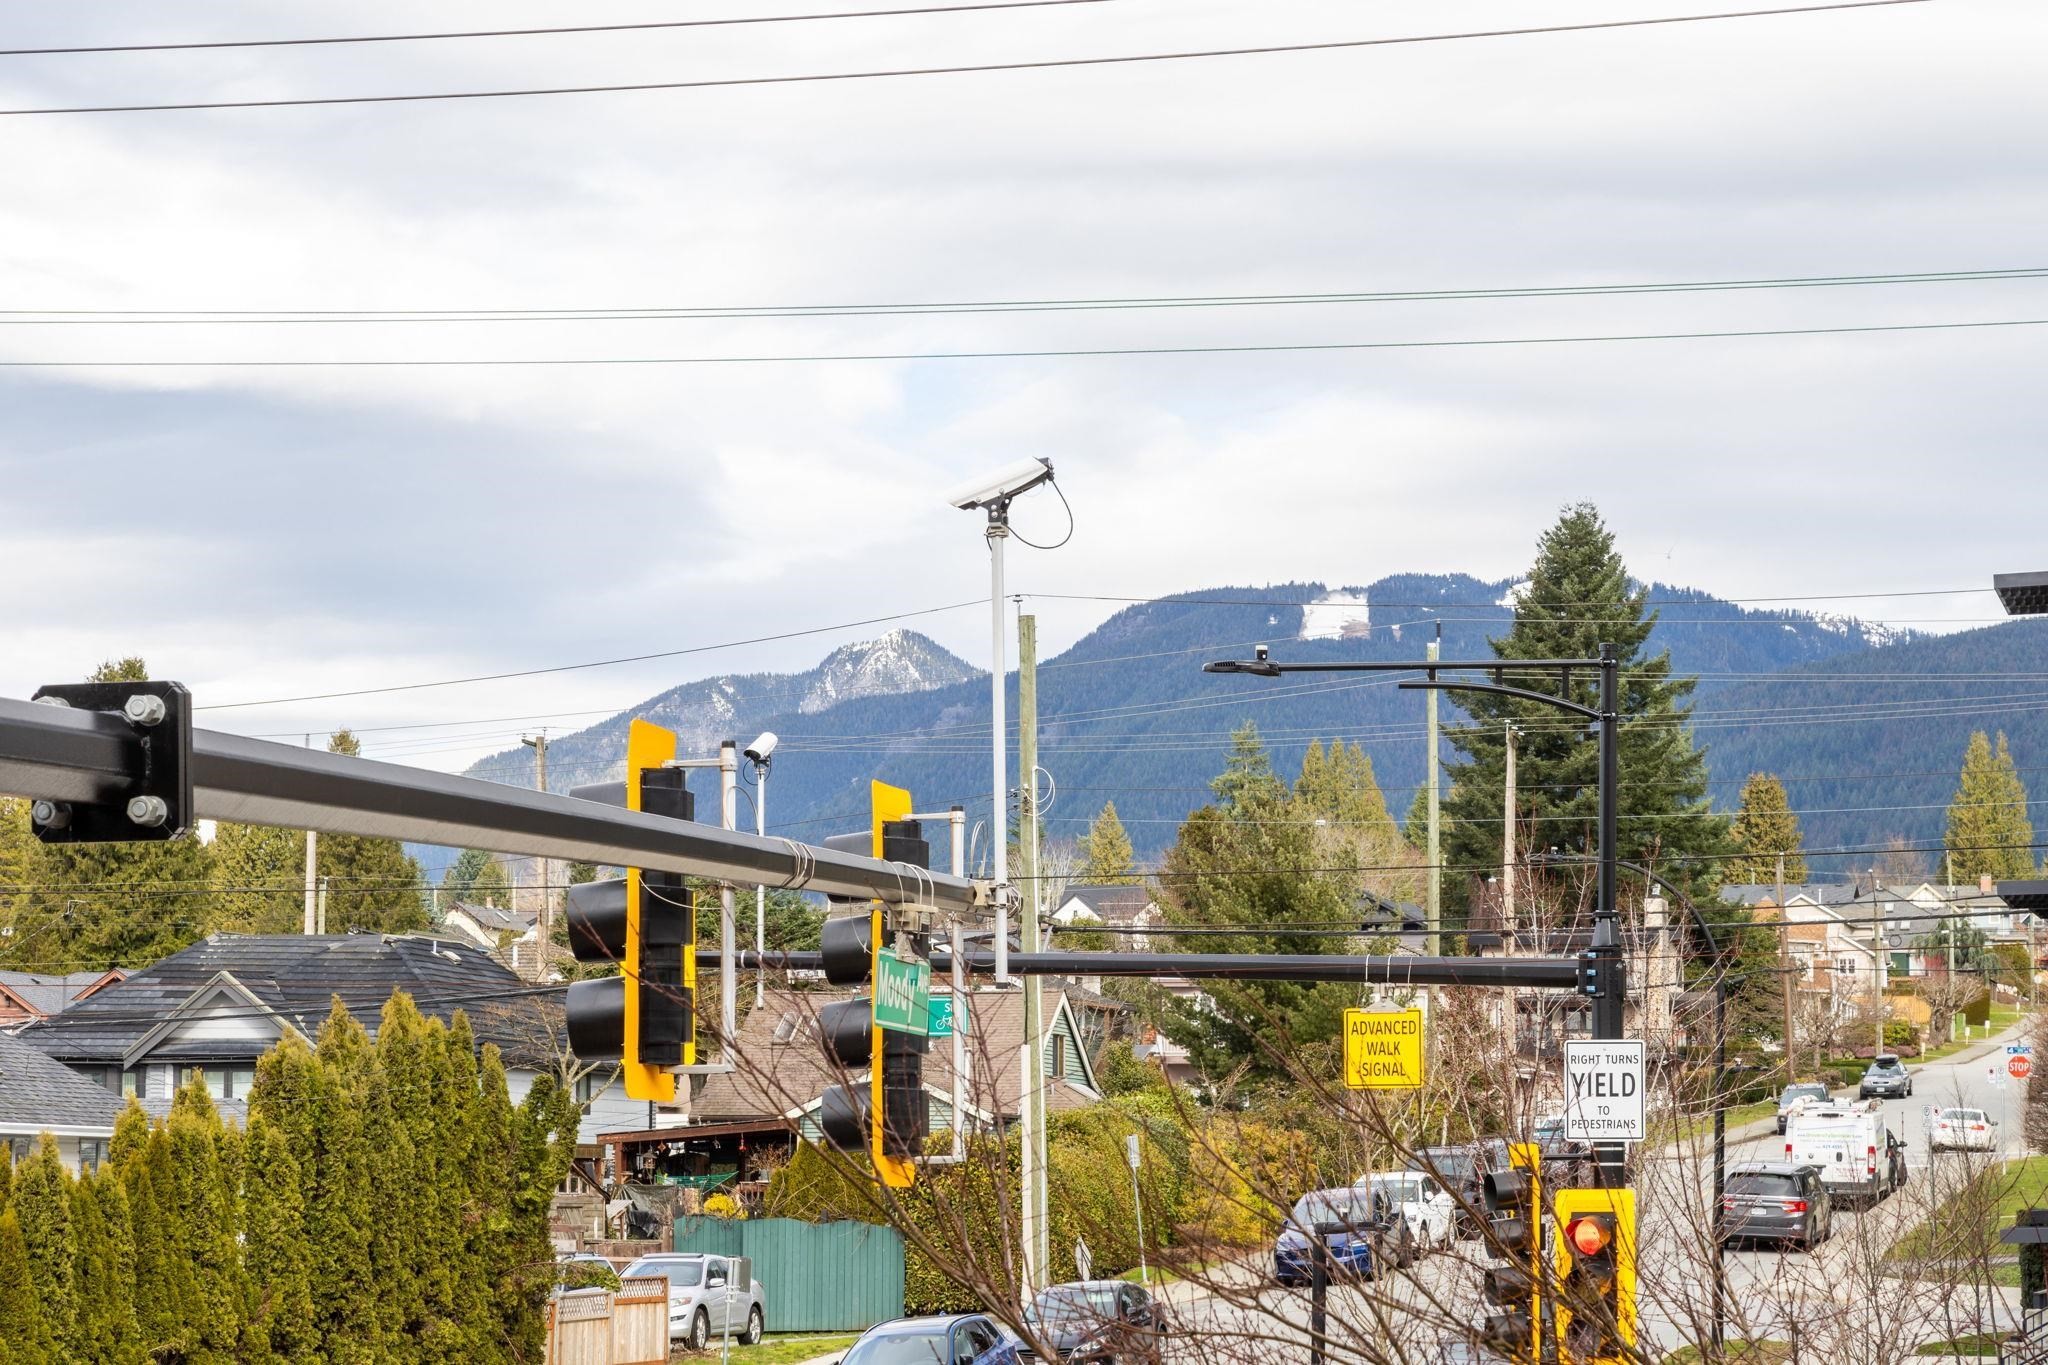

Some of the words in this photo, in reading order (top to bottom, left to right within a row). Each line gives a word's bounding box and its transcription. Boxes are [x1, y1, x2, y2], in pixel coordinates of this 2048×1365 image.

[878, 960, 915, 1023] Moody
[1351, 1020, 1417, 1035] ADVANCED
[1366, 1041, 1401, 1056] WALK
[1570, 1054, 1601, 1065] RIGHT
[1605, 1054, 1639, 1065] TURNS
[2009, 1062, 2030, 1072] STOP
[1362, 1061, 1406, 1077] SIGNAL
[1570, 1072, 1636, 1098] YIELD
[1597, 1105, 1610, 1116] TO
[1571, 1119, 1636, 1130] PEDESTRIANS
